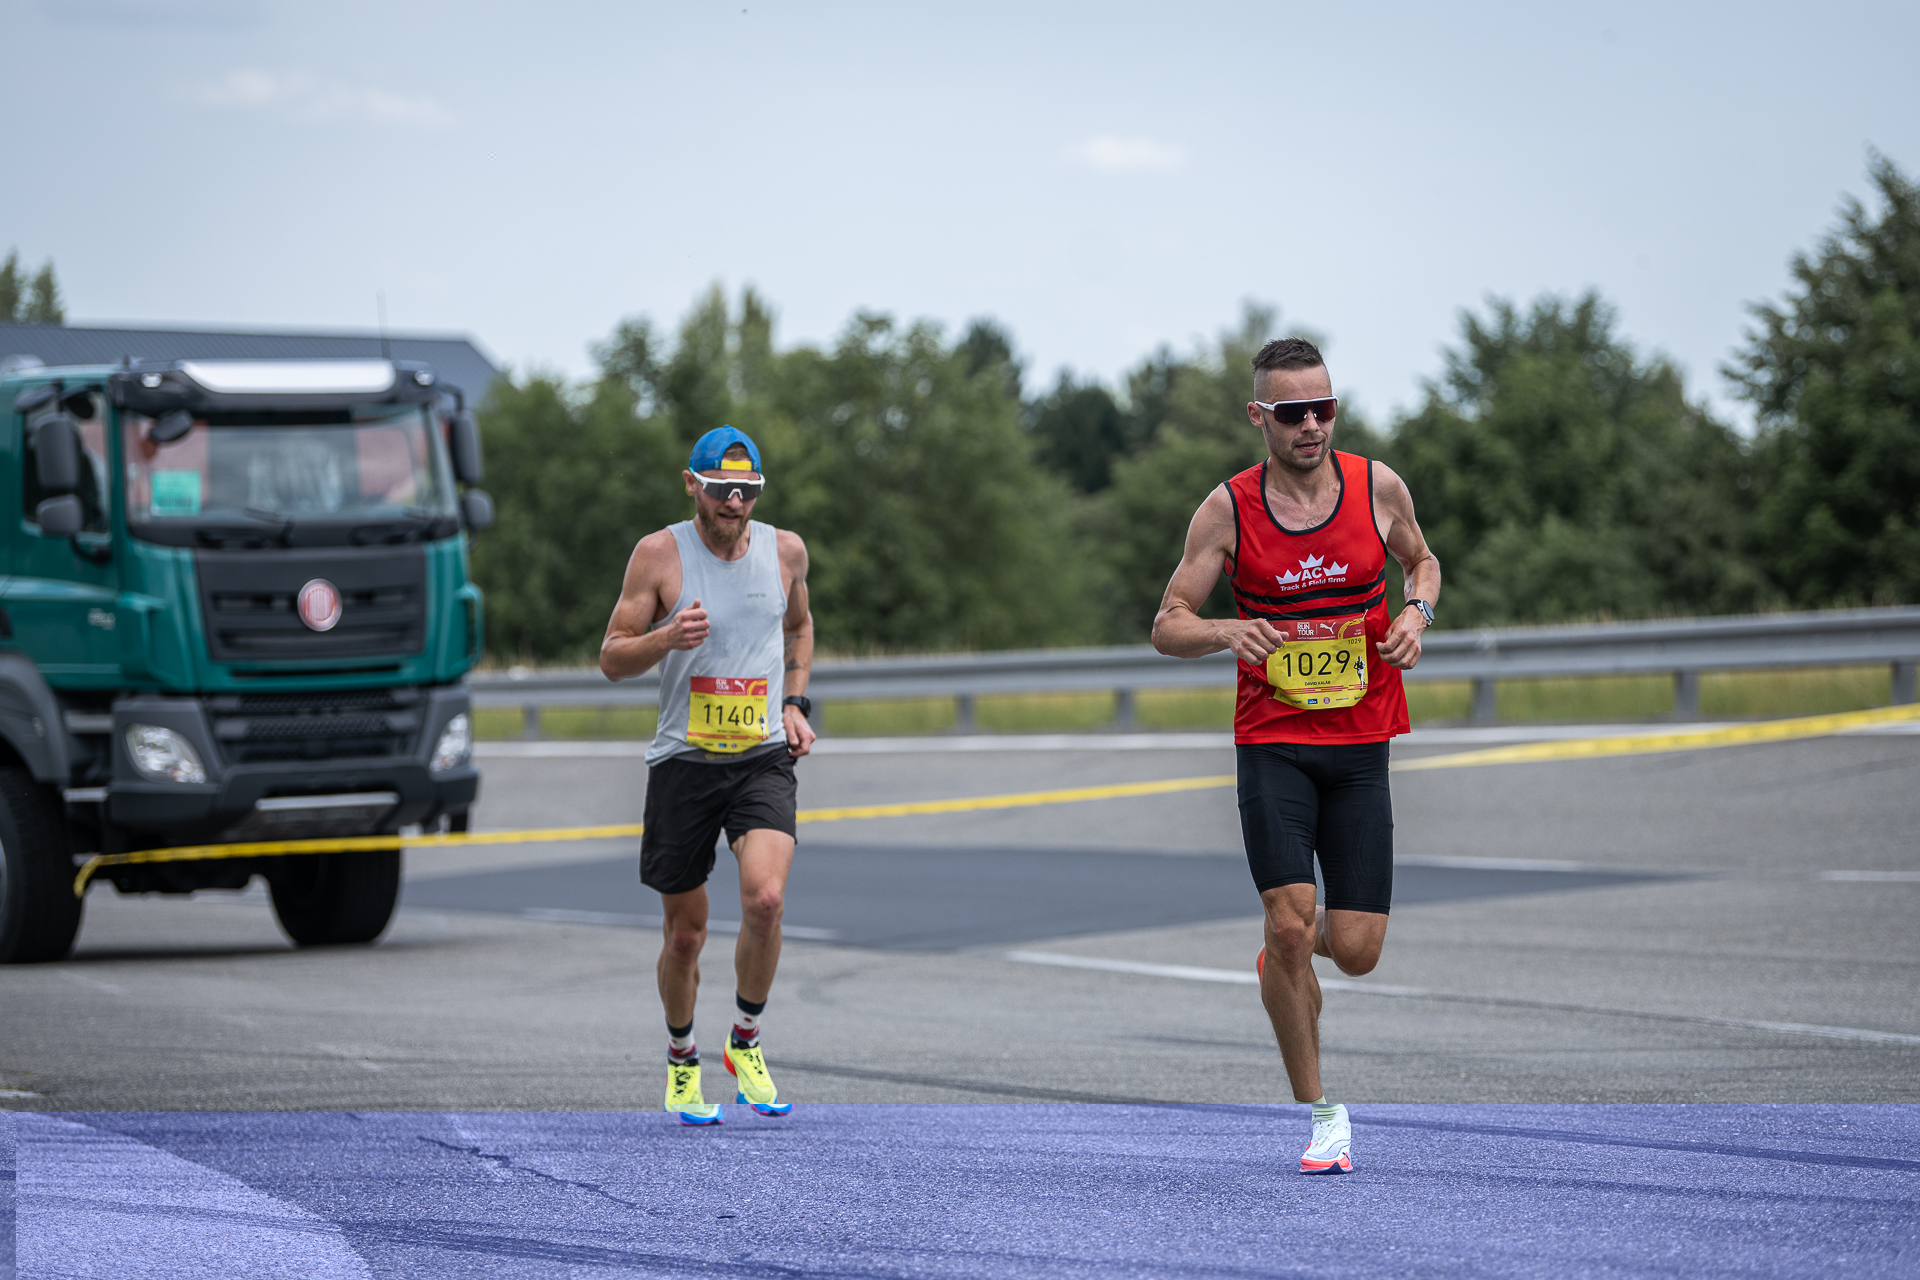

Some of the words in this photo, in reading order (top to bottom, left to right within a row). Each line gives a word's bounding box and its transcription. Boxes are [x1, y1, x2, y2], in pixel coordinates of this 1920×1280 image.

[1301, 567, 1322, 581] AC
[1309, 578, 1326, 586] Field
[1297, 622, 1310, 630] RUN
[1282, 650, 1351, 677] 1029
[703, 704, 754, 726] 1140
